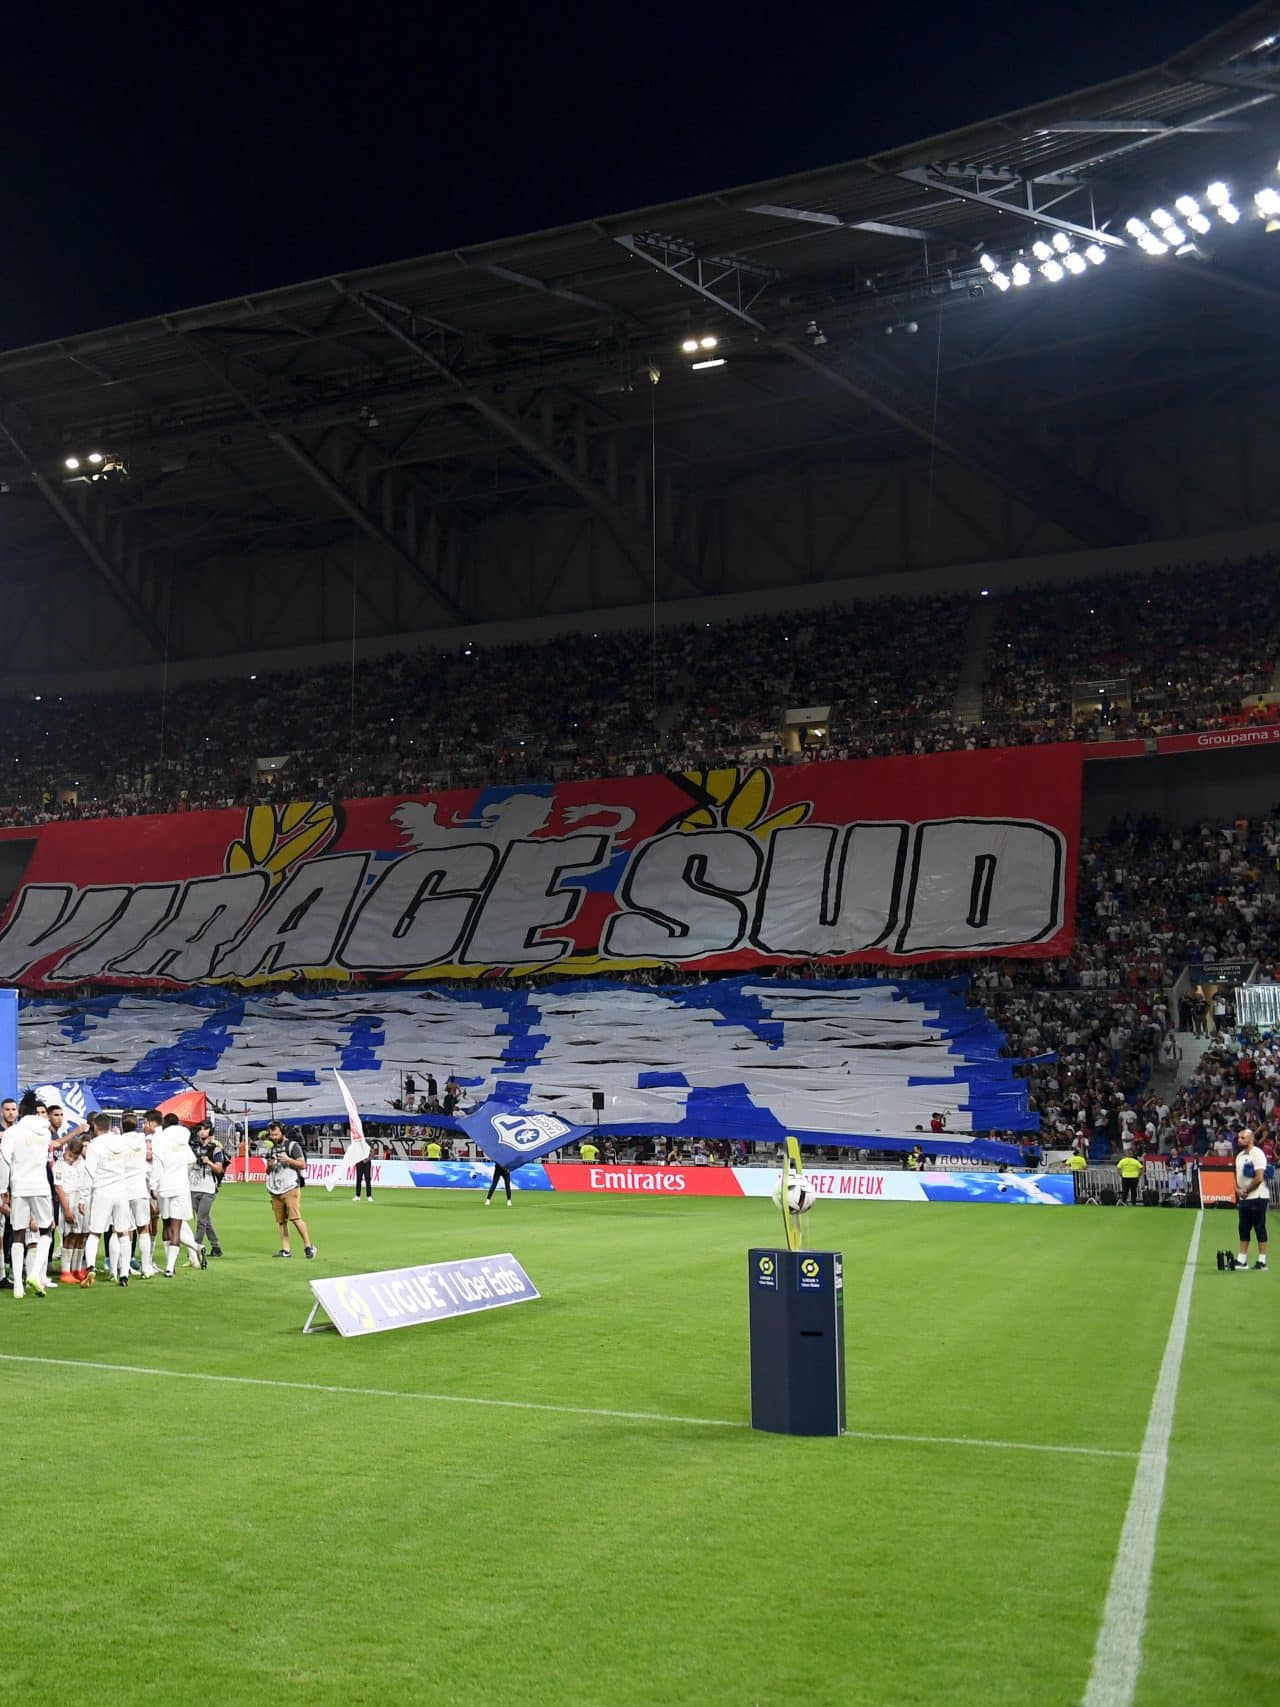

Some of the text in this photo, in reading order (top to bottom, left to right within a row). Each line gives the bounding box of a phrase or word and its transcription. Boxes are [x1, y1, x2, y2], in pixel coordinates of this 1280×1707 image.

[1197, 731, 1269, 746] Groupama
[599, 817, 1067, 961] SUD
[589, 1168, 686, 1191] Emirates
[840, 1175, 885, 1195] MIEUX
[370, 1266, 526, 1317] LIGUE 1 Uber Eats
